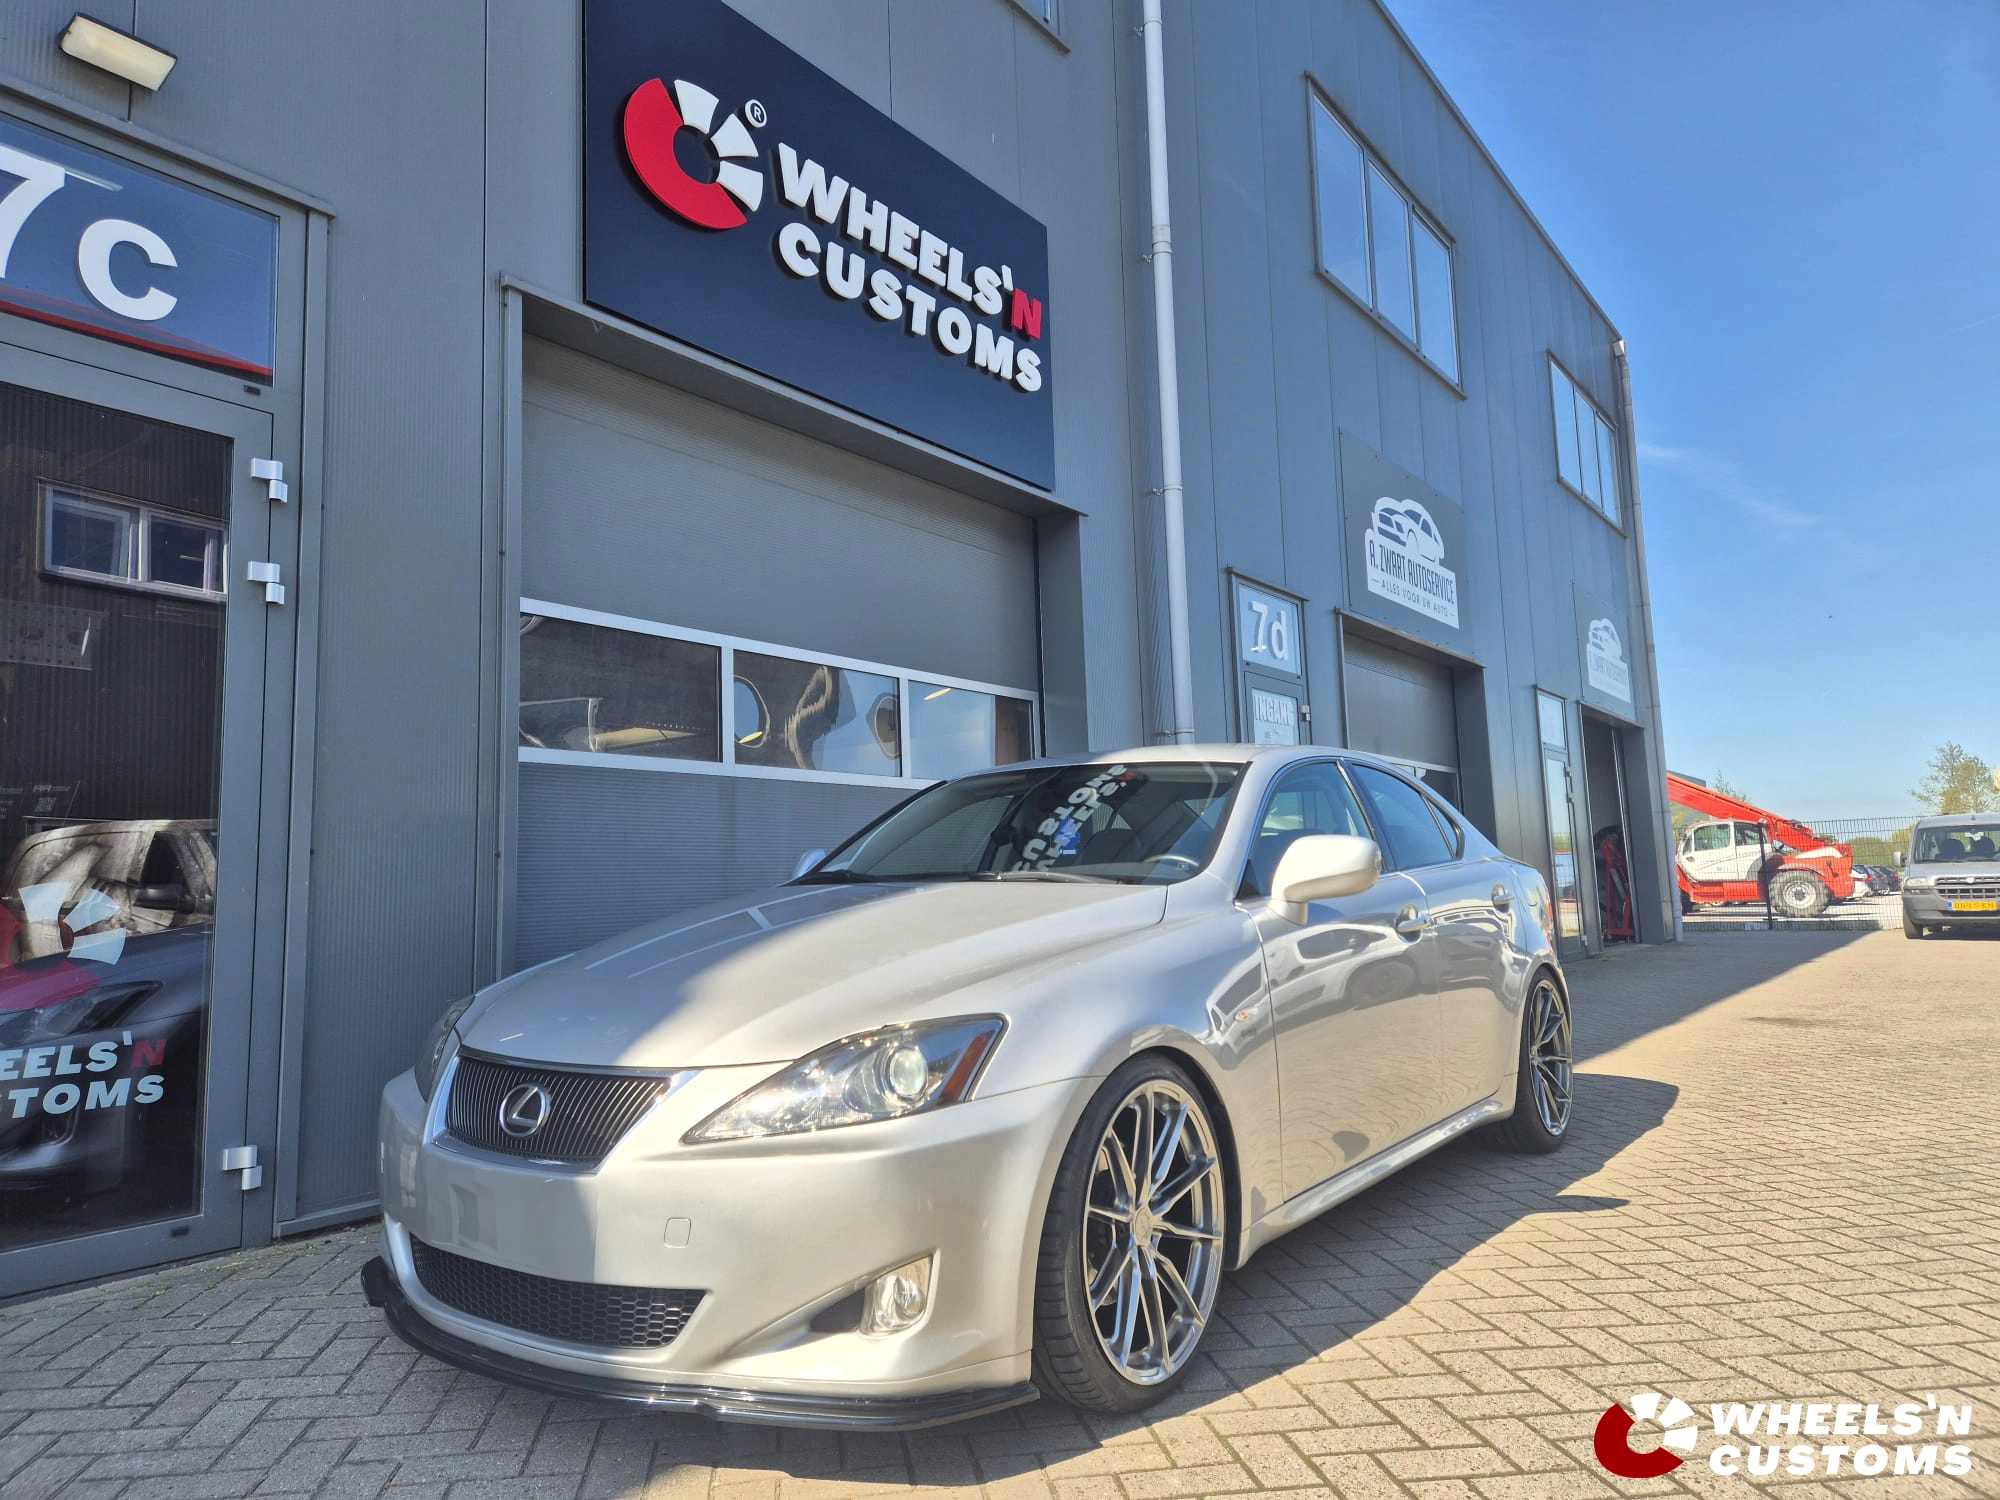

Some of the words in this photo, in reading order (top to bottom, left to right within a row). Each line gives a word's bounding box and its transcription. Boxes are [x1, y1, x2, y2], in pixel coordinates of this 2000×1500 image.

[778, 142, 1042, 340] WHEELS'N
[778, 222, 1042, 392] CUSTOMS
[1379, 544, 1407, 581] ZWART
[1407, 558, 1455, 605] AUTOSERVICE
[1381, 580, 1401, 596] ALLES
[1402, 587, 1420, 603] VOOR
[1251, 600, 1289, 661] 7d
[0, 1074, 165, 1119] TOMS
